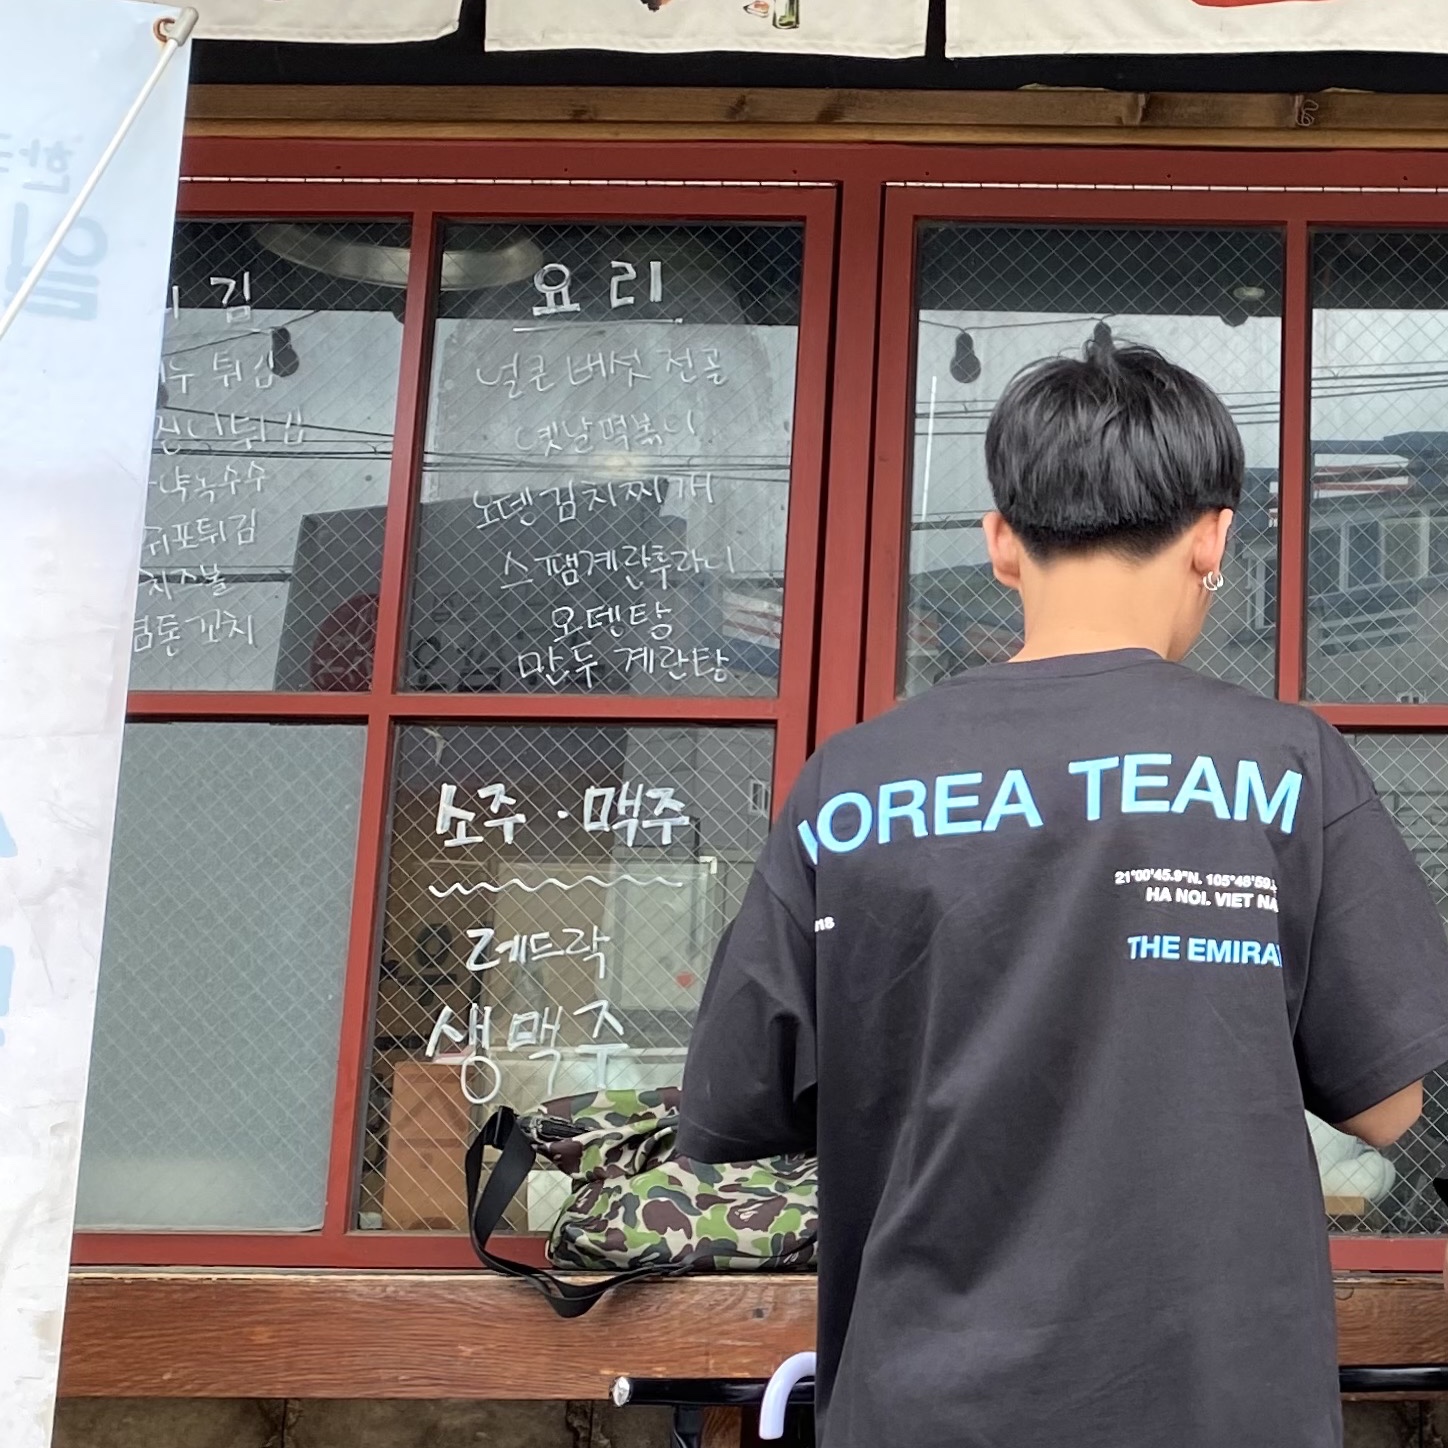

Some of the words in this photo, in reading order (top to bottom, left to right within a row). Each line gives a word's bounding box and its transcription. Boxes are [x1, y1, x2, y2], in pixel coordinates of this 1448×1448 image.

[517, 641, 599, 688] 만두
[435, 782, 527, 848] 소주
[583, 780, 691, 848] 맥주
[1067, 752, 1304, 835] TEAM
[1145, 885, 1173, 903] HA
[1214, 890, 1255, 909] VIET
[465, 924, 611, 979] 레드락
[1127, 934, 1182, 960] THE
[1187, 937, 1283, 968] EMIRA
[424, 999, 630, 1105] 생맥주
